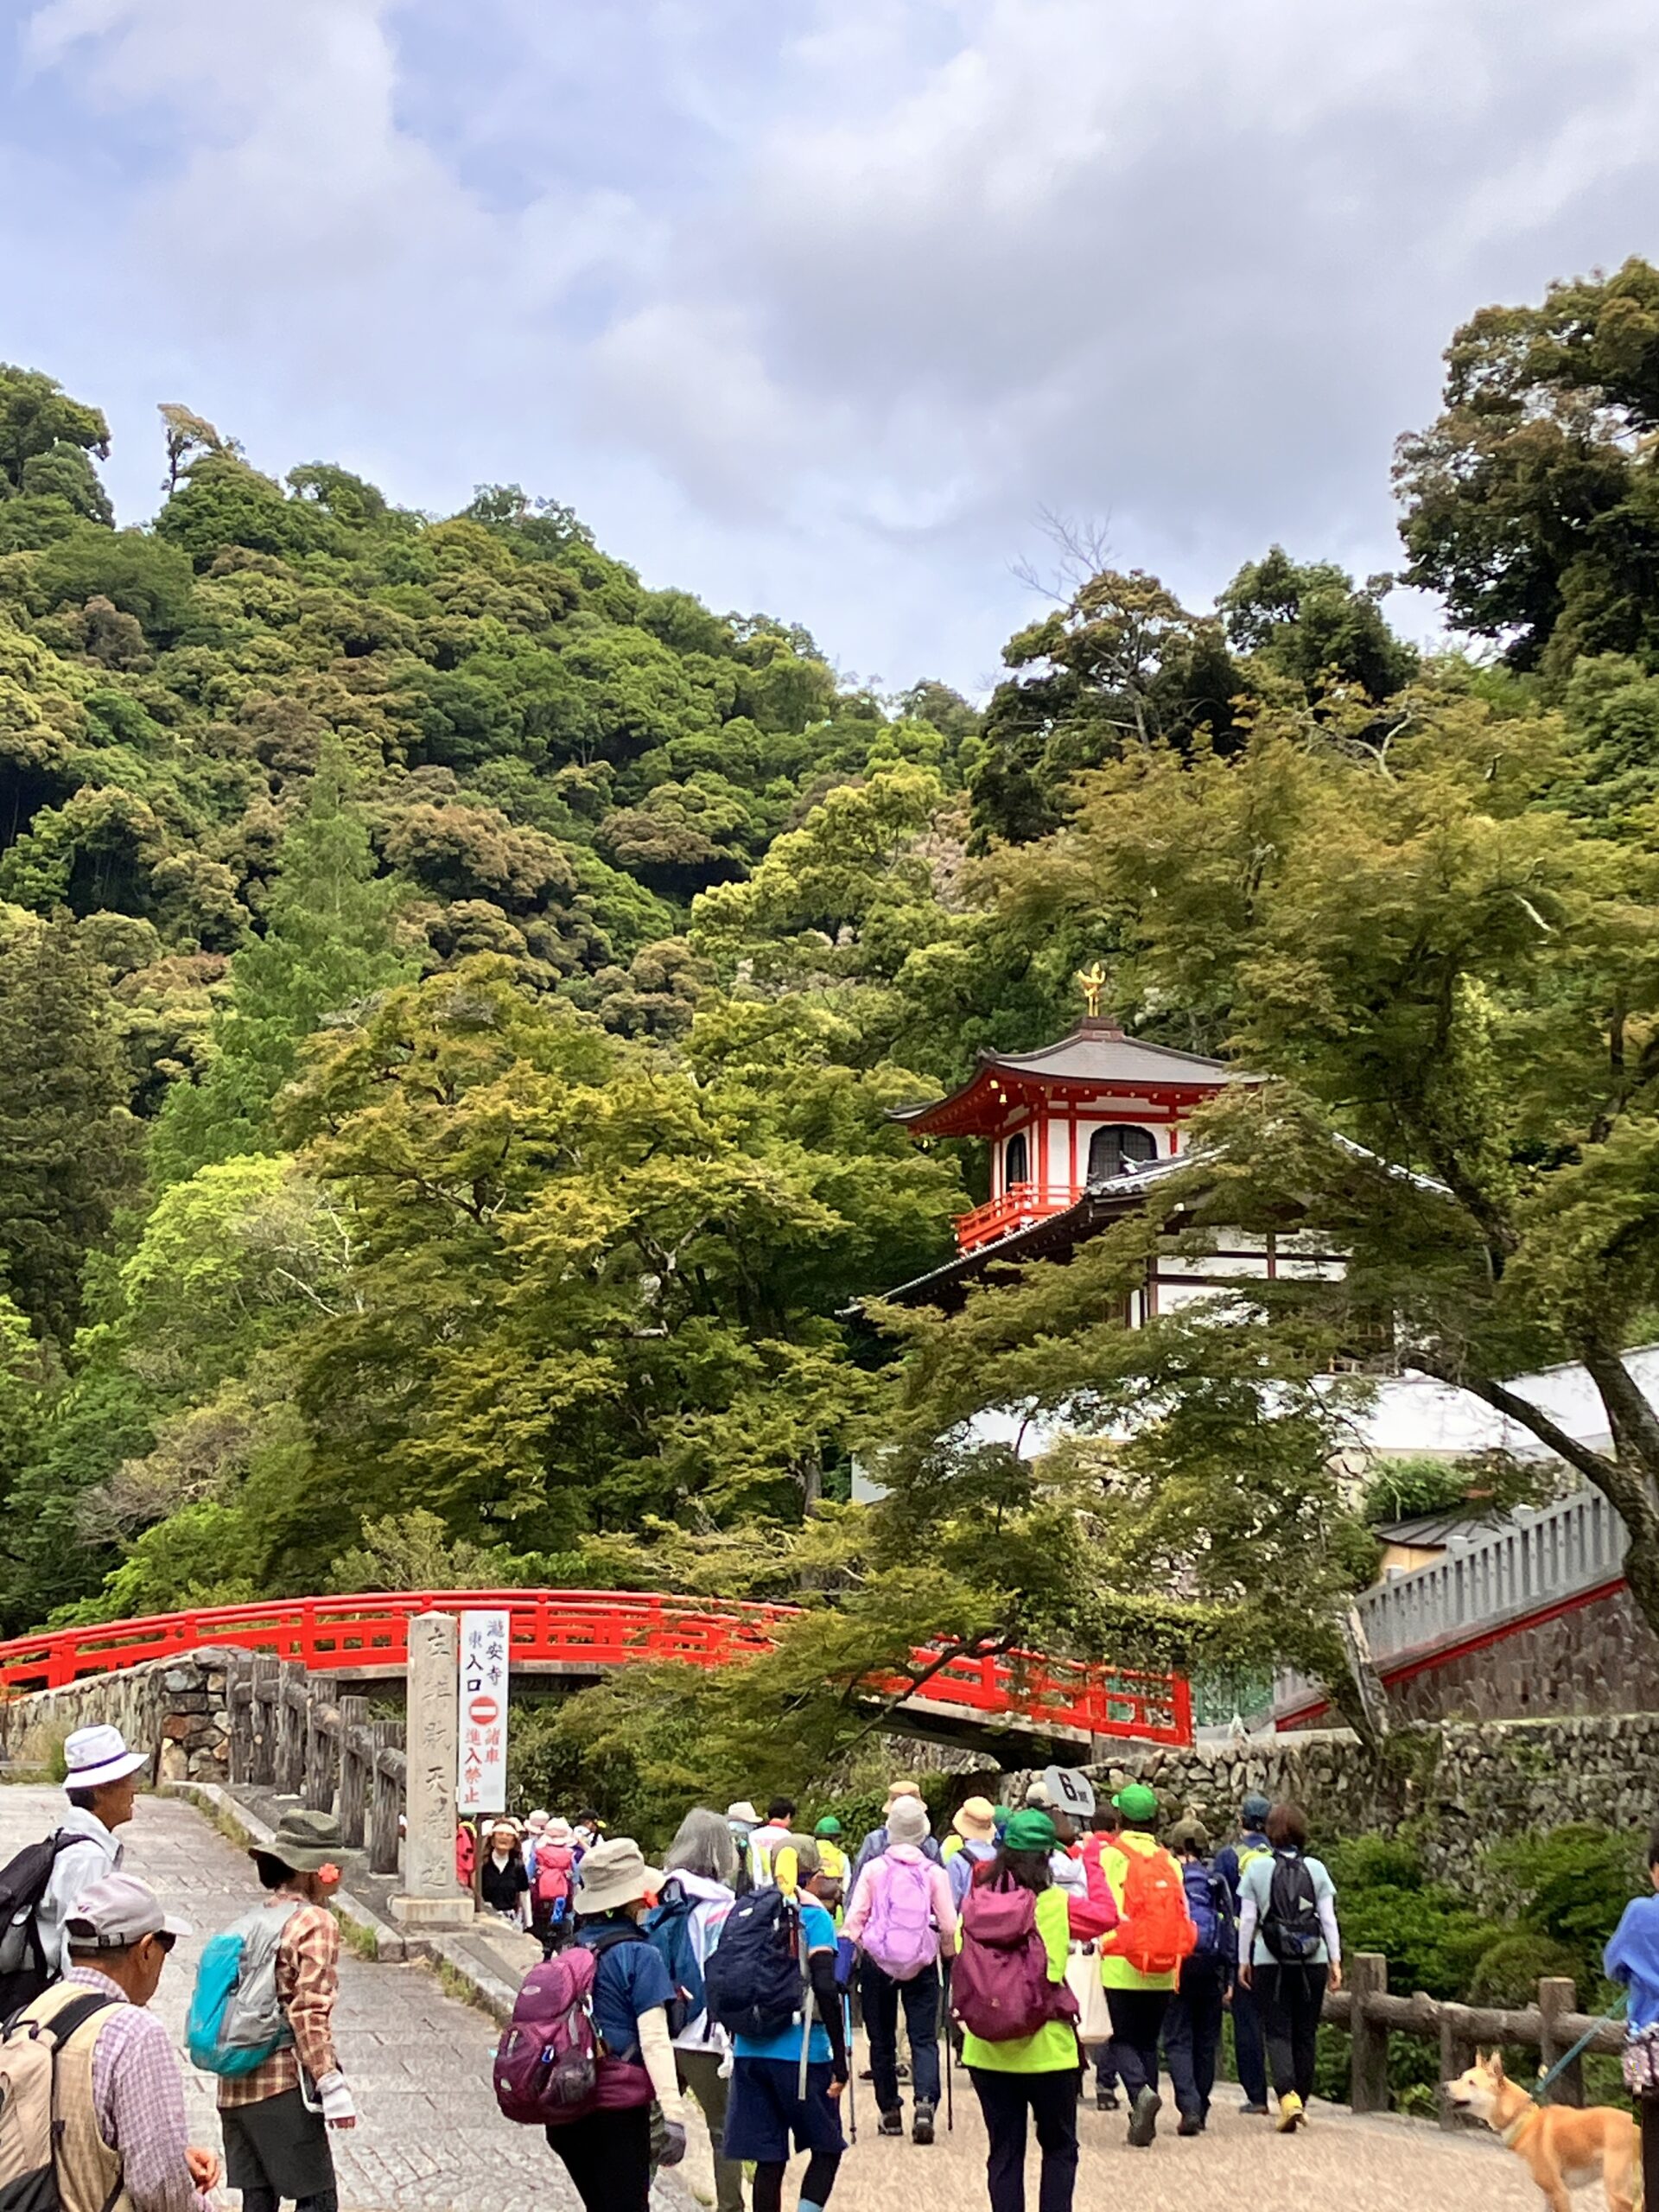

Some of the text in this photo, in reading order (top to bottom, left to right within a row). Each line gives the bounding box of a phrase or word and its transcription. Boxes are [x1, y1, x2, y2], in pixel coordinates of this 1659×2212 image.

[466, 1630, 483, 1692] 東入口
[465, 1728, 482, 1803] 進入禁止
[485, 1727, 500, 1764] 諸車
